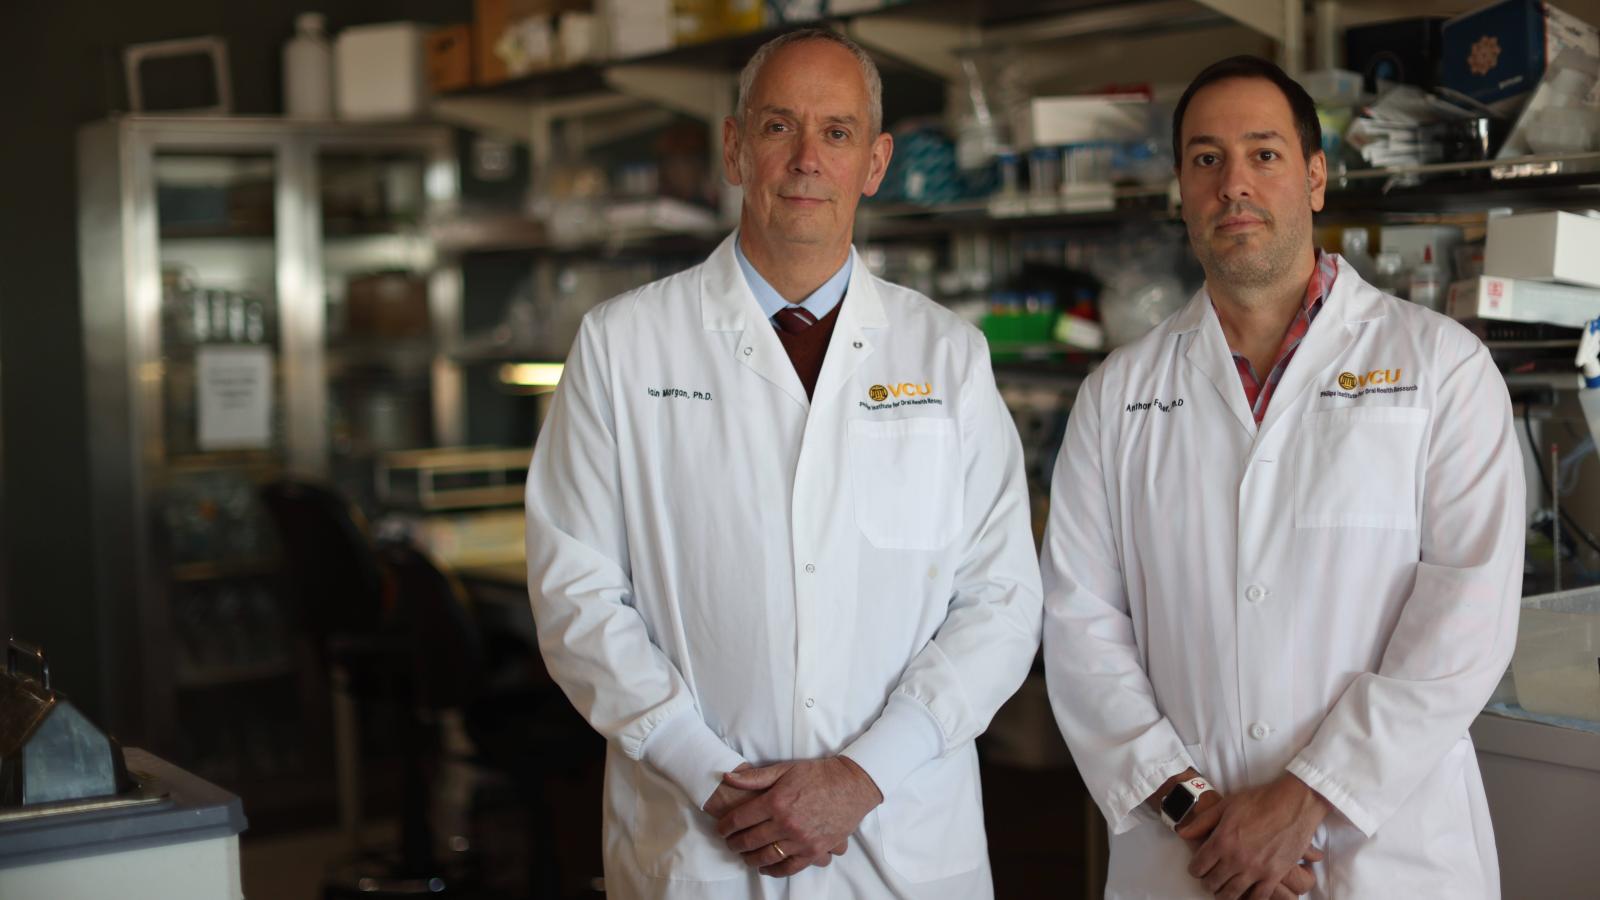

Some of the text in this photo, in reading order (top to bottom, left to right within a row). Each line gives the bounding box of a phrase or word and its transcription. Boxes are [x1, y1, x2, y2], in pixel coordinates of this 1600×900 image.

[1357, 367, 1402, 387] VCU
[647, 387, 713, 401] Iain Morgan, Ph.D.
[886, 383, 932, 398] VCU
[1365, 387, 1377, 395] Oral
[1377, 386, 1394, 394] Health
[1394, 384, 1418, 393] Research
